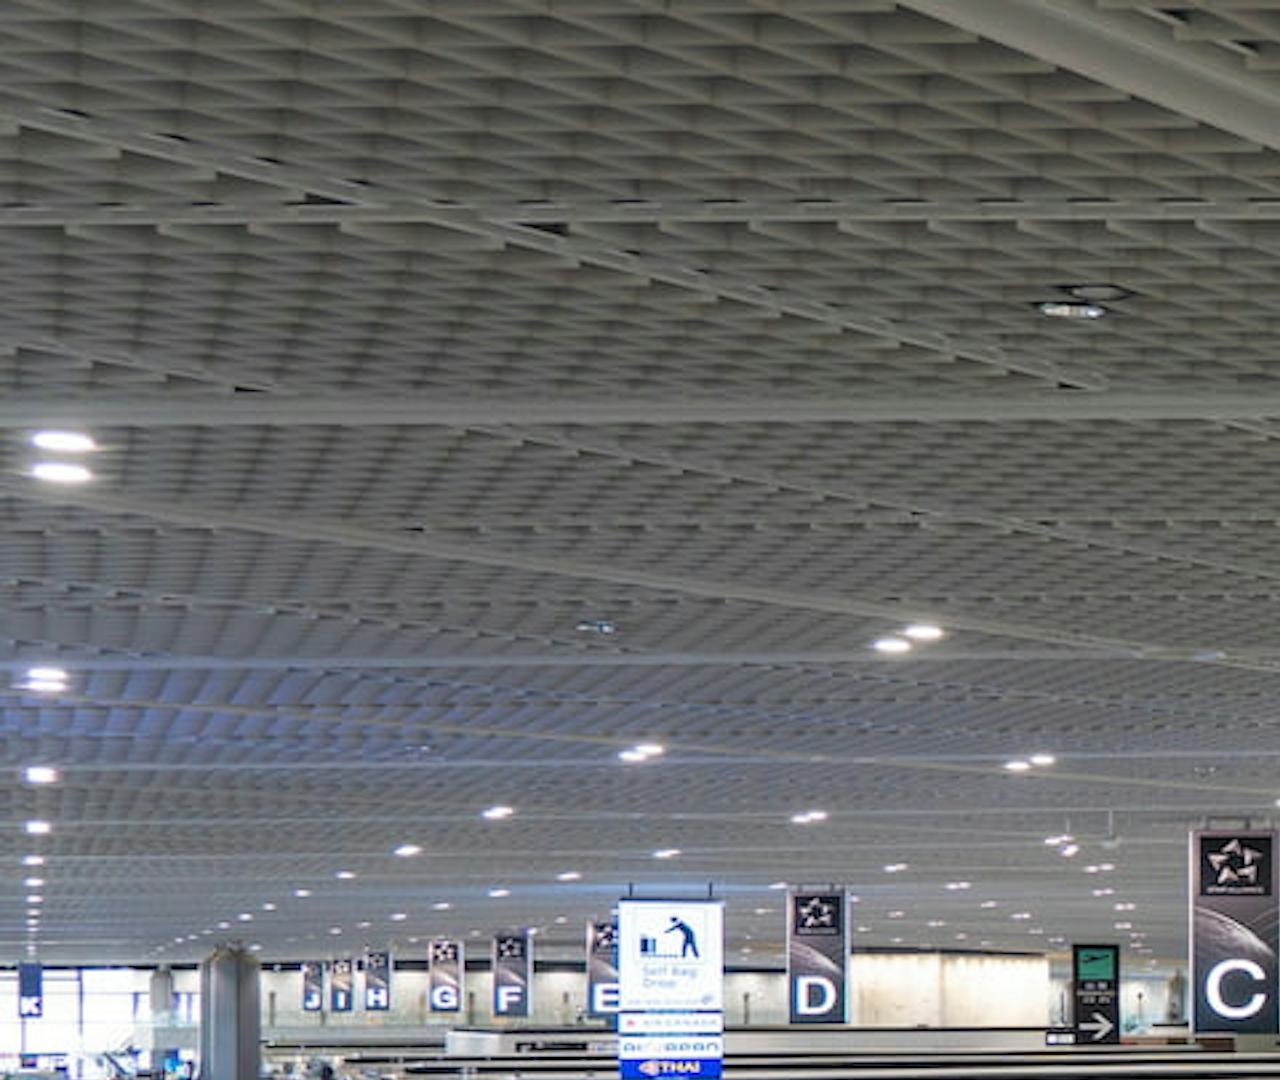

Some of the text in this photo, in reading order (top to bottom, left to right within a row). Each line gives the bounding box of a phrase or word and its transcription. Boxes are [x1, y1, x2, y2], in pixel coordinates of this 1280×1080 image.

[304, 988, 321, 1009] J
[366, 988, 388, 1007] H
[432, 985, 458, 1007] G
[498, 986, 523, 1012] F
[593, 982, 619, 1012] E
[796, 975, 836, 1015] D
[1206, 958, 1267, 1020] C
[21, 996, 41, 1014] K
[659, 1061, 701, 1073] THAI
